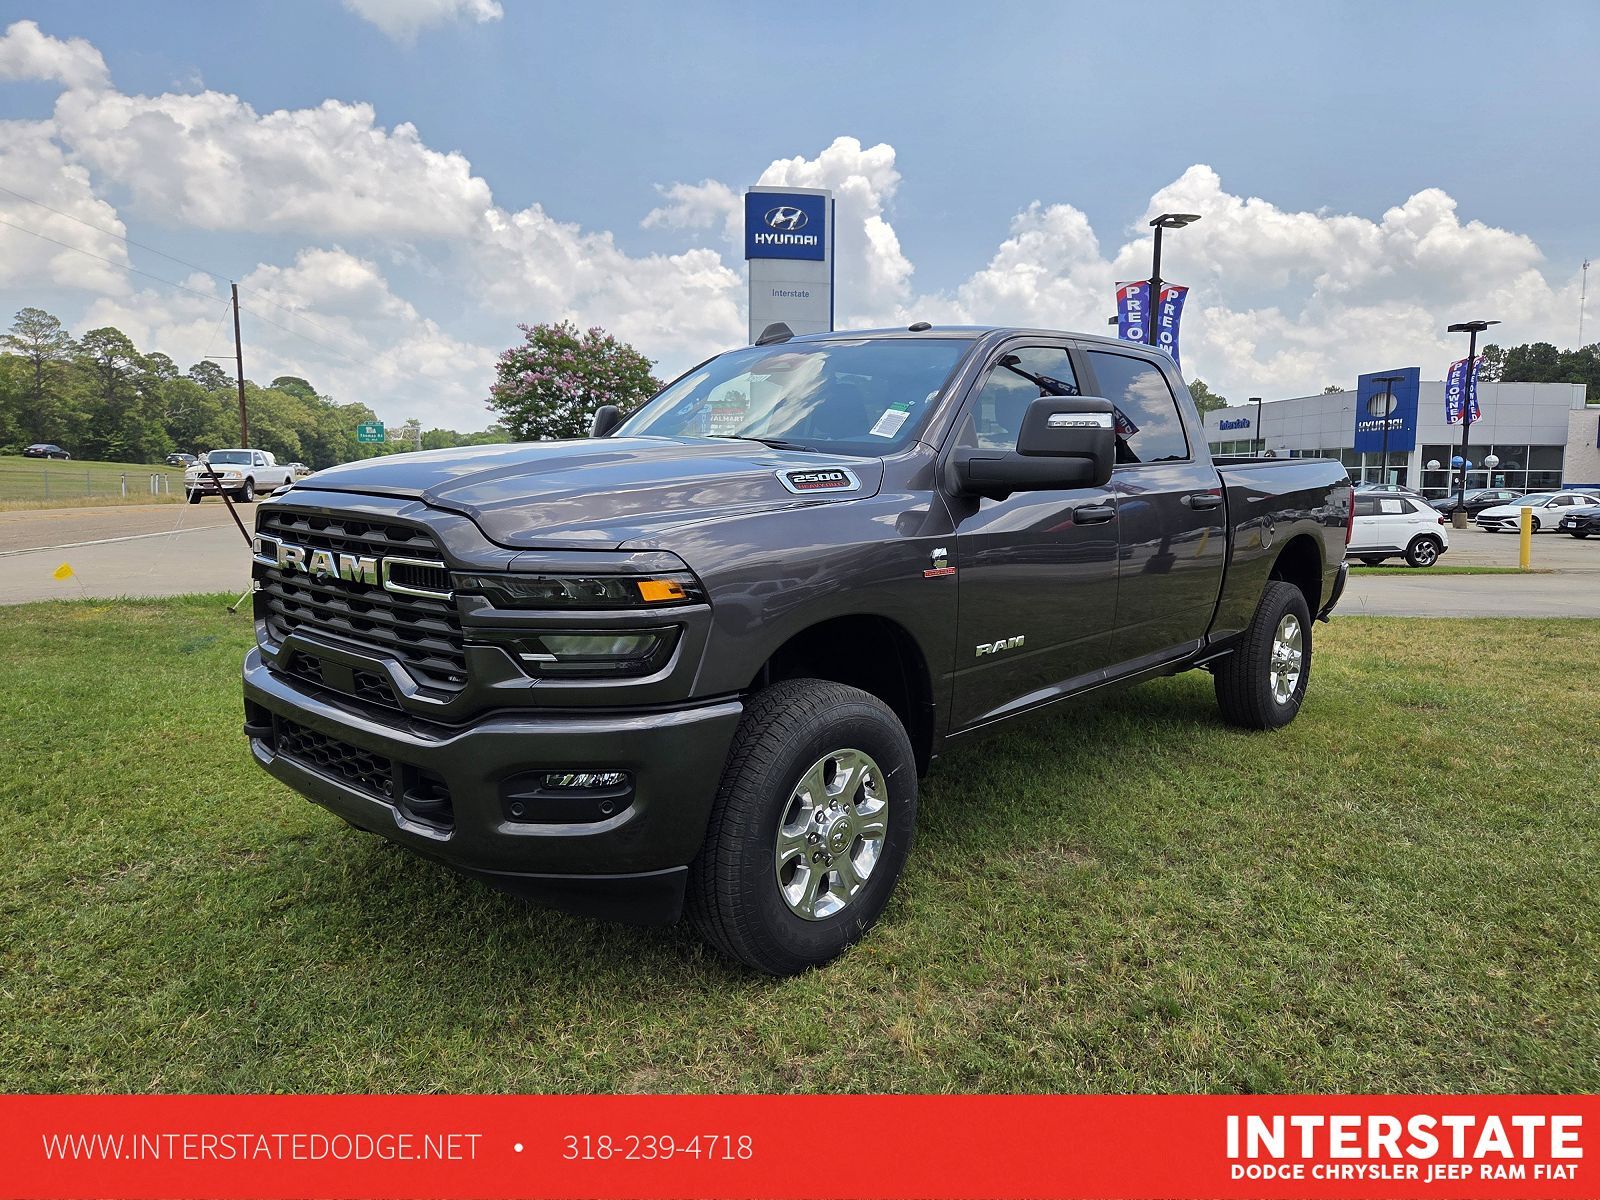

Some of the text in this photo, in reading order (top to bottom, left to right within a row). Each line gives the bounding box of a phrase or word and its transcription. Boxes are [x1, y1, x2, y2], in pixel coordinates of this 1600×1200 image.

[755, 233, 818, 246] HYUNDAI
[772, 288, 810, 298] Interstate
[1219, 418, 1251, 430] Interstate
[792, 472, 843, 483] 2500
[278, 542, 378, 586] RAM
[976, 635, 1025, 657] RAM
